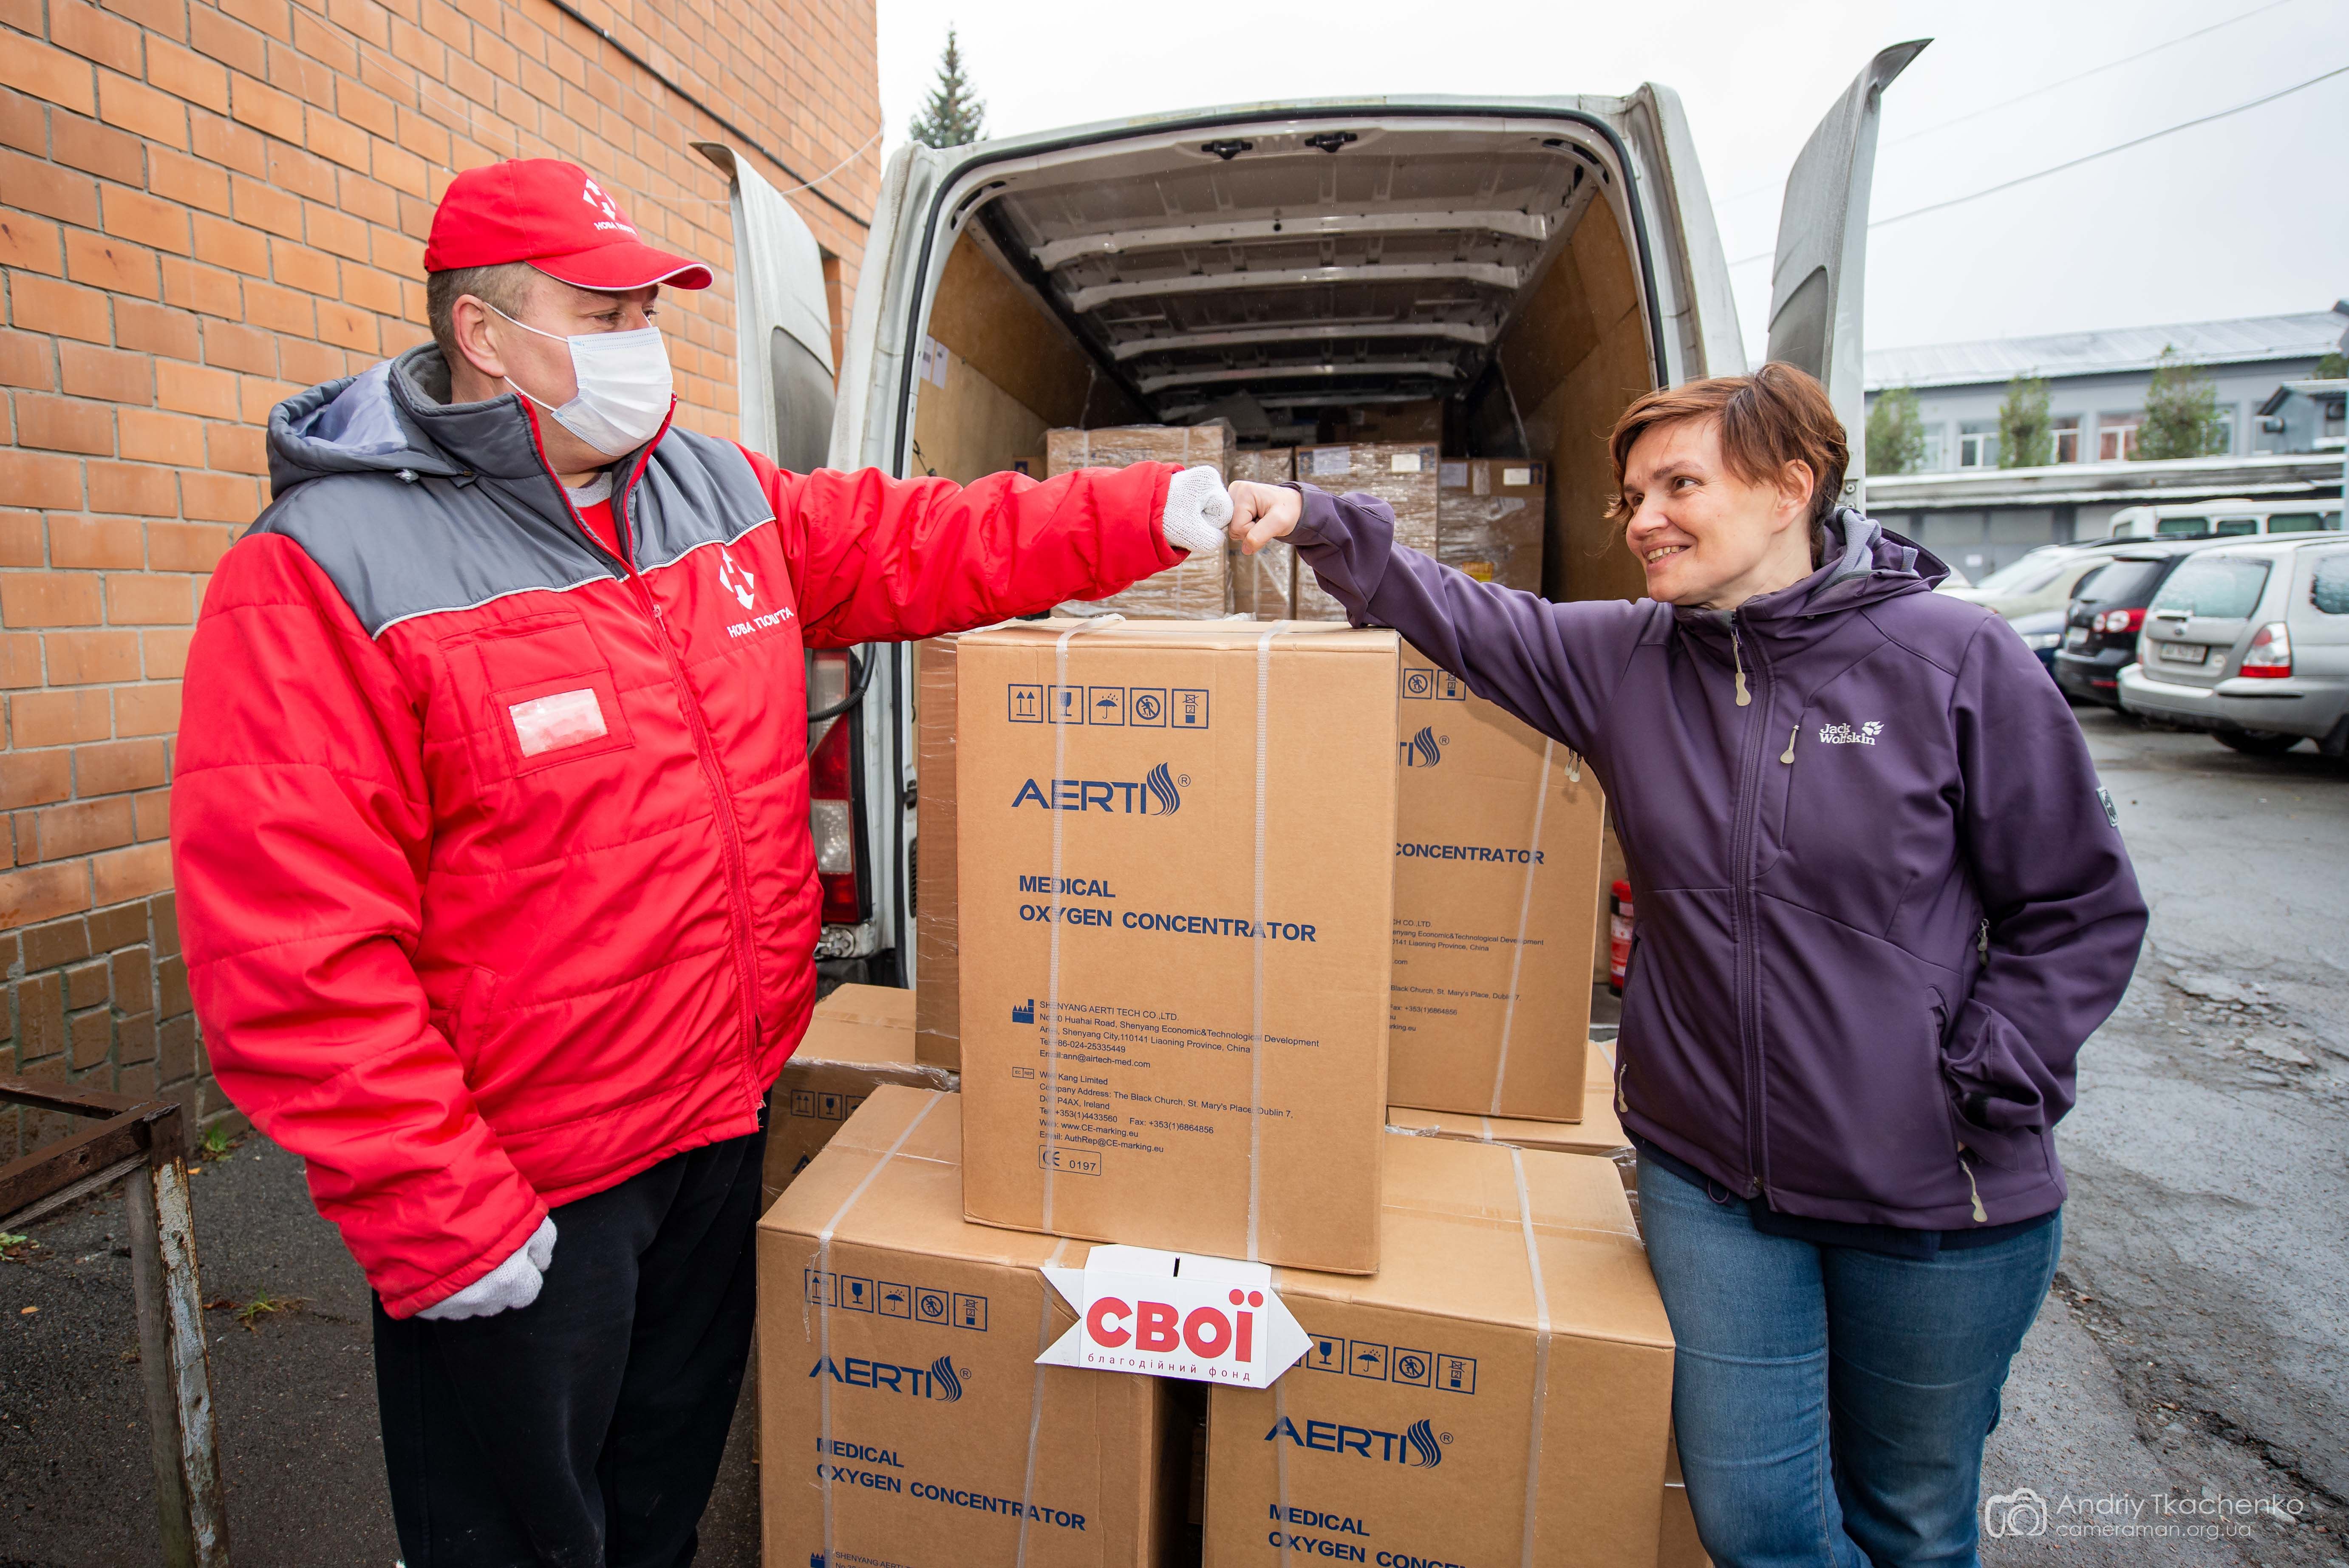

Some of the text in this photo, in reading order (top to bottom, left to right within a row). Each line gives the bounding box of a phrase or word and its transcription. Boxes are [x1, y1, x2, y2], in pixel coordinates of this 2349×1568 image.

[726, 607, 794, 638] НОВА ПОШТА
[1820, 723, 1851, 734] Jack
[1819, 732, 1876, 745] Wolfskin
[1019, 875, 1116, 898] MEDICAL
[1019, 904, 1317, 942] OXYGEN CONCENTRATOR
[1409, 940, 1436, 949] Liaoning
[1438, 942, 1468, 951] Province,
[1418, 931, 1499, 943] Economic&Technological
[1500, 937, 1544, 945] Devepment
[1410, 986, 1435, 995] Church,
[1448, 989, 1469, 997] Mary's
[1471, 991, 1491, 999] Place,
[1040, 1001, 1180, 1021] SHNYANG AERTI TECH CO.,LTD.
[1405, 1006, 1458, 1016] +353(1)6864856
[1062, 1027, 1101, 1040] Shenyang
[1103, 1032, 1148, 1044] City,110141
[1151, 1036, 1184, 1048] Liaoning
[1187, 1040, 1224, 1052] Province,
[1227, 1044, 1251, 1053] China
[1065, 1016, 1092, 1025] Huahai
[1095, 1019, 1117, 1028] Road,
[1120, 1021, 1159, 1033] Shenyang
[1162, 1025, 1262, 1042] Economic&Technologic
[1265, 1035, 1319, 1047] Development
[1040, 1050, 1150, 1068] Emil:ann@airtech-med.com
[1058, 1073, 1078, 1084] Kang
[1081, 1075, 1108, 1085] Limited
[1039, 1083, 1076, 1095] Copany
[1078, 1088, 1111, 1098] Address:
[1113, 1091, 1129, 1100] The
[1131, 1093, 1152, 1102] Black
[1155, 1096, 1185, 1107] Church,
[1188, 1099, 1199, 1108] St.
[1201, 1101, 1228, 1112] Mary's
[1258, 1107, 1283, 1117] Dublin
[1285, 1110, 1293, 1119] 7,
[1057, 1097, 1081, 1107] P4AX,
[1084, 1100, 1110, 1110] Ireland
[1056, 1109, 1118, 1123] +353(1)4433560
[1129, 1118, 1146, 1126] Fax:
[1149, 1121, 1214, 1134] +353(1)6864856
[1061, 1123, 1139, 1138] www.CE-marking.eu
[1064, 1134, 1164, 1153] AuthRep@CE-marking.eu
[1070, 1160, 1096, 1171] 0197
[1088, 1353, 1251, 1382] благодійний фонд
[816, 1437, 904, 1468] MEDICAL
[816, 1464, 1086, 1531] OXYGEN CONCENTRATOR
[1269, 1504, 1370, 1537] MEDICAL
[1268, 1531, 1365, 1563] OXYGEN
[835, 1551, 879, 1566] SHENYANG
